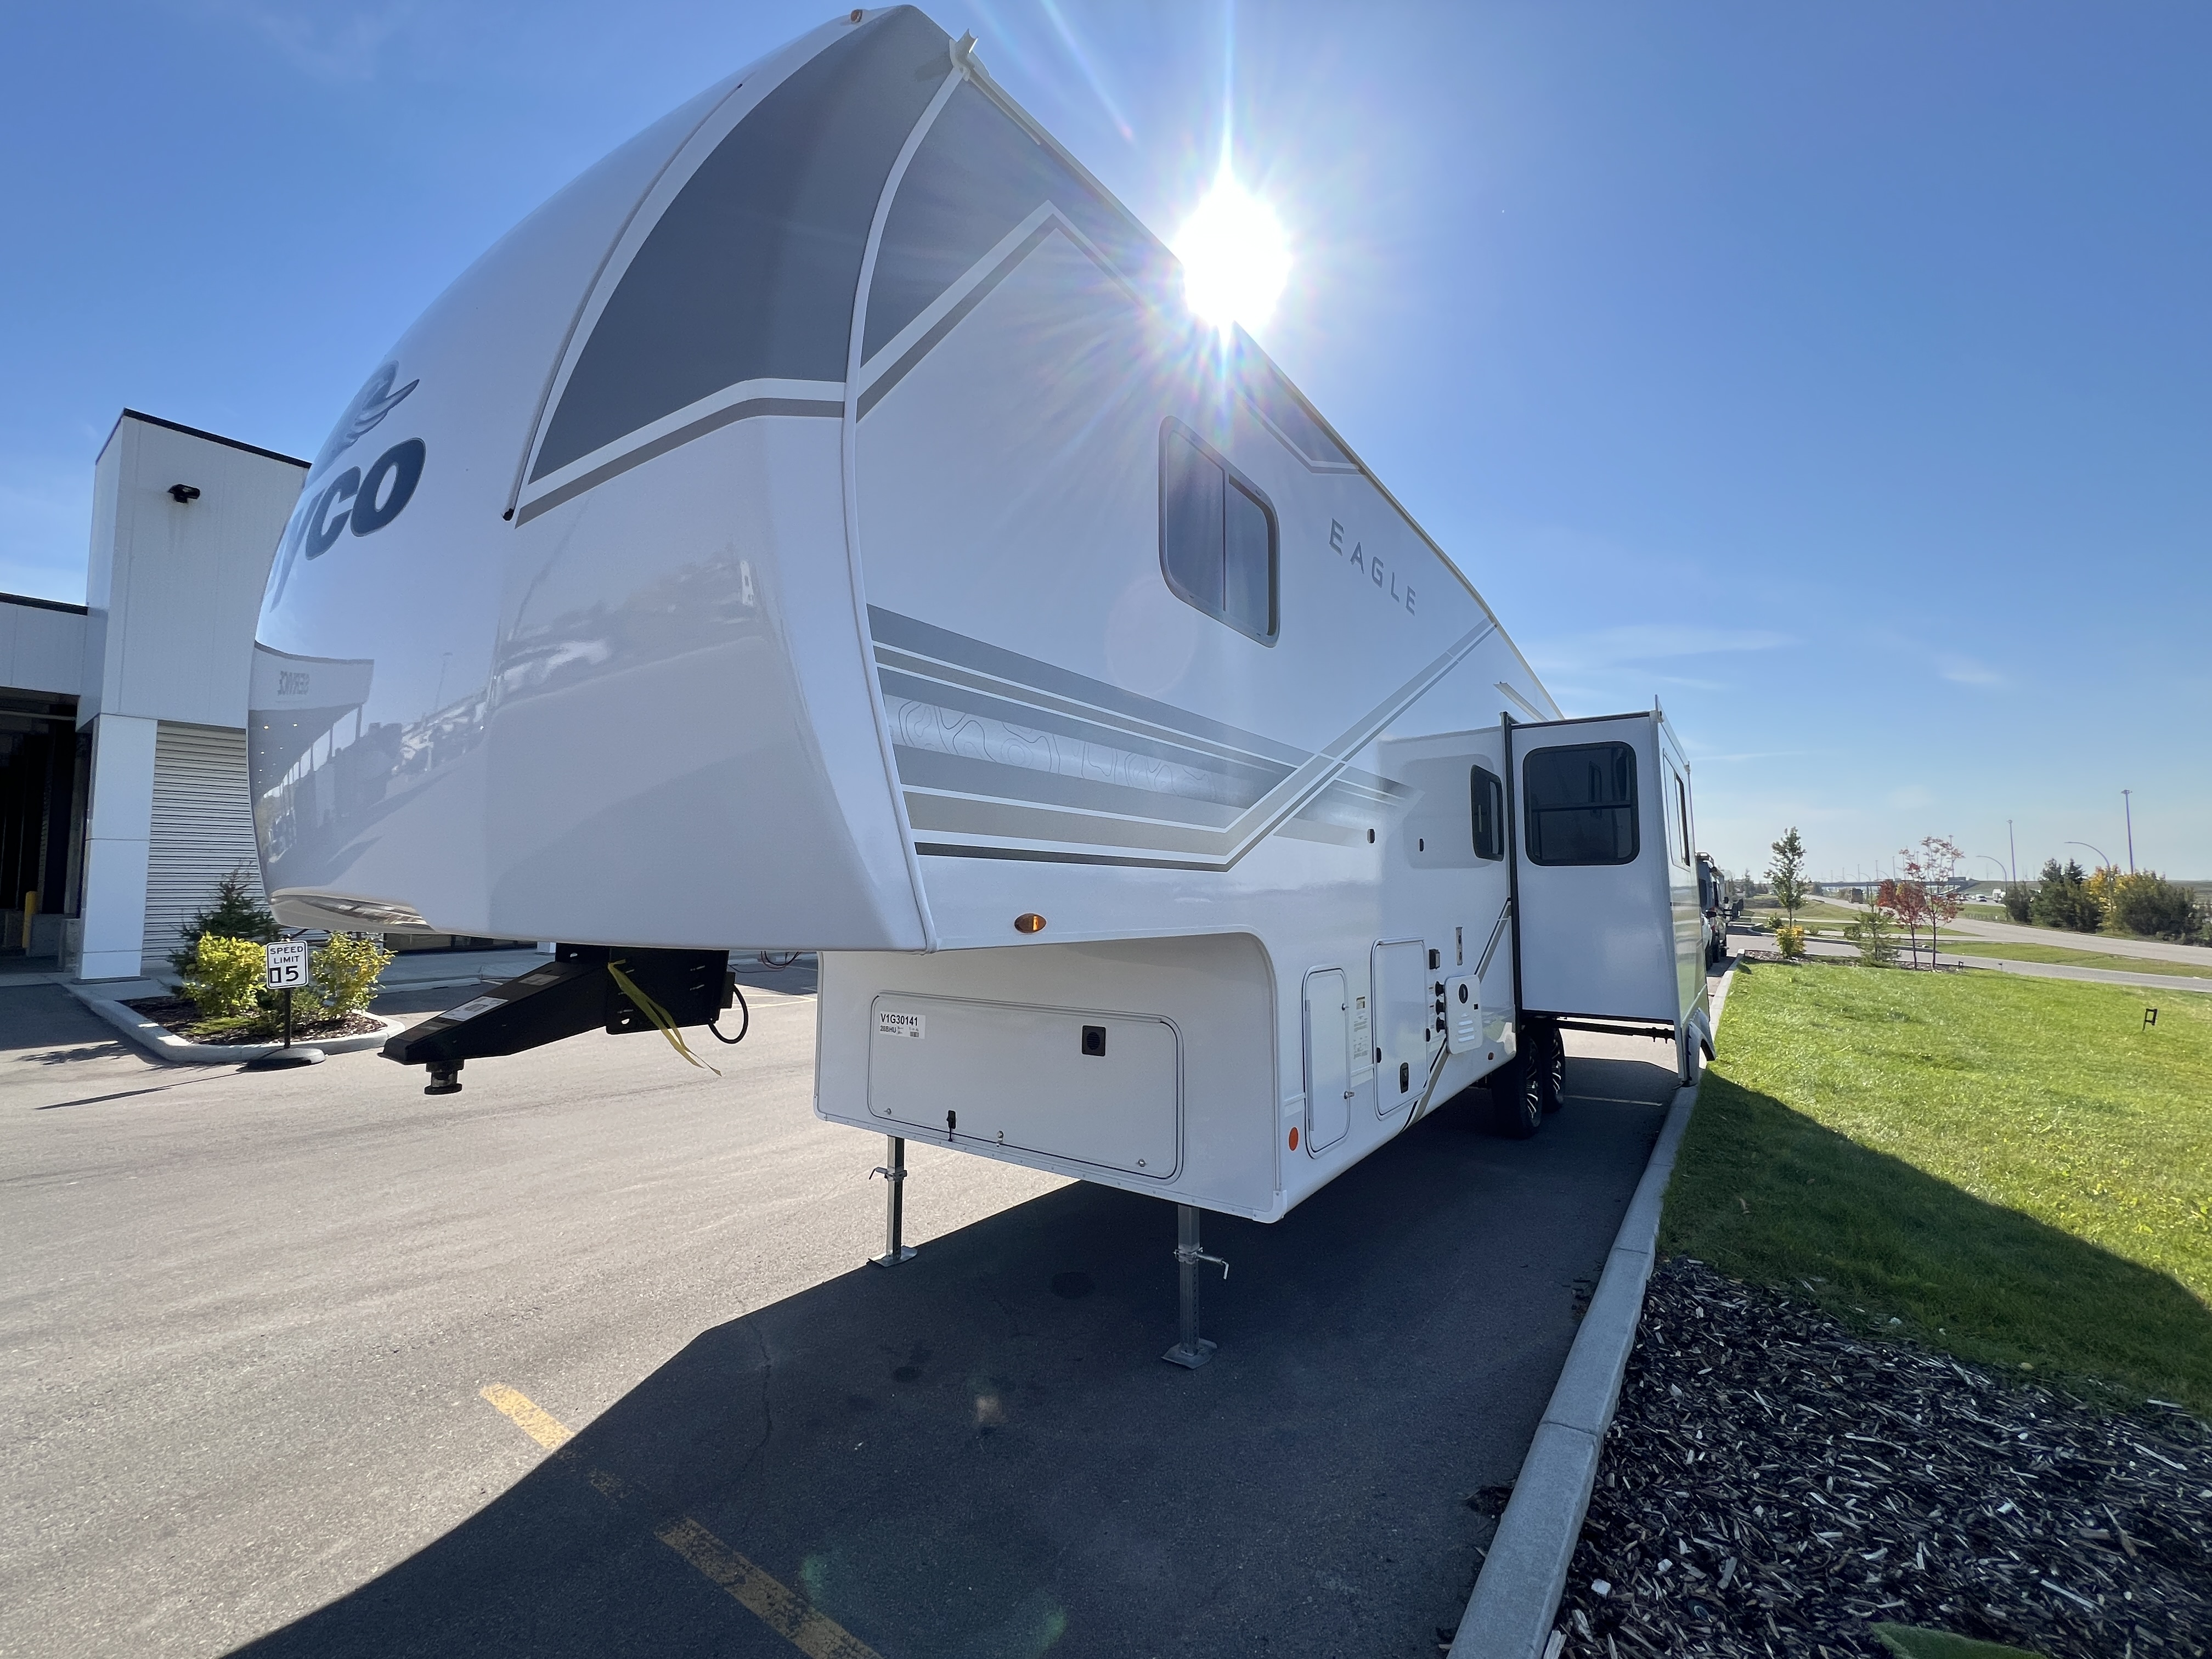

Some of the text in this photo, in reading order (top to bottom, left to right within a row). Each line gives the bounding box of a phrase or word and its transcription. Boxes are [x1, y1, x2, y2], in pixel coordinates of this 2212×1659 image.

[267, 437, 426, 612] YCO
[1329, 518, 1416, 616] EAGLE
[270, 946, 303, 955] SPEED
[274, 956, 300, 964] LIMIT
[881, 1013, 918, 1026] V1G30141
